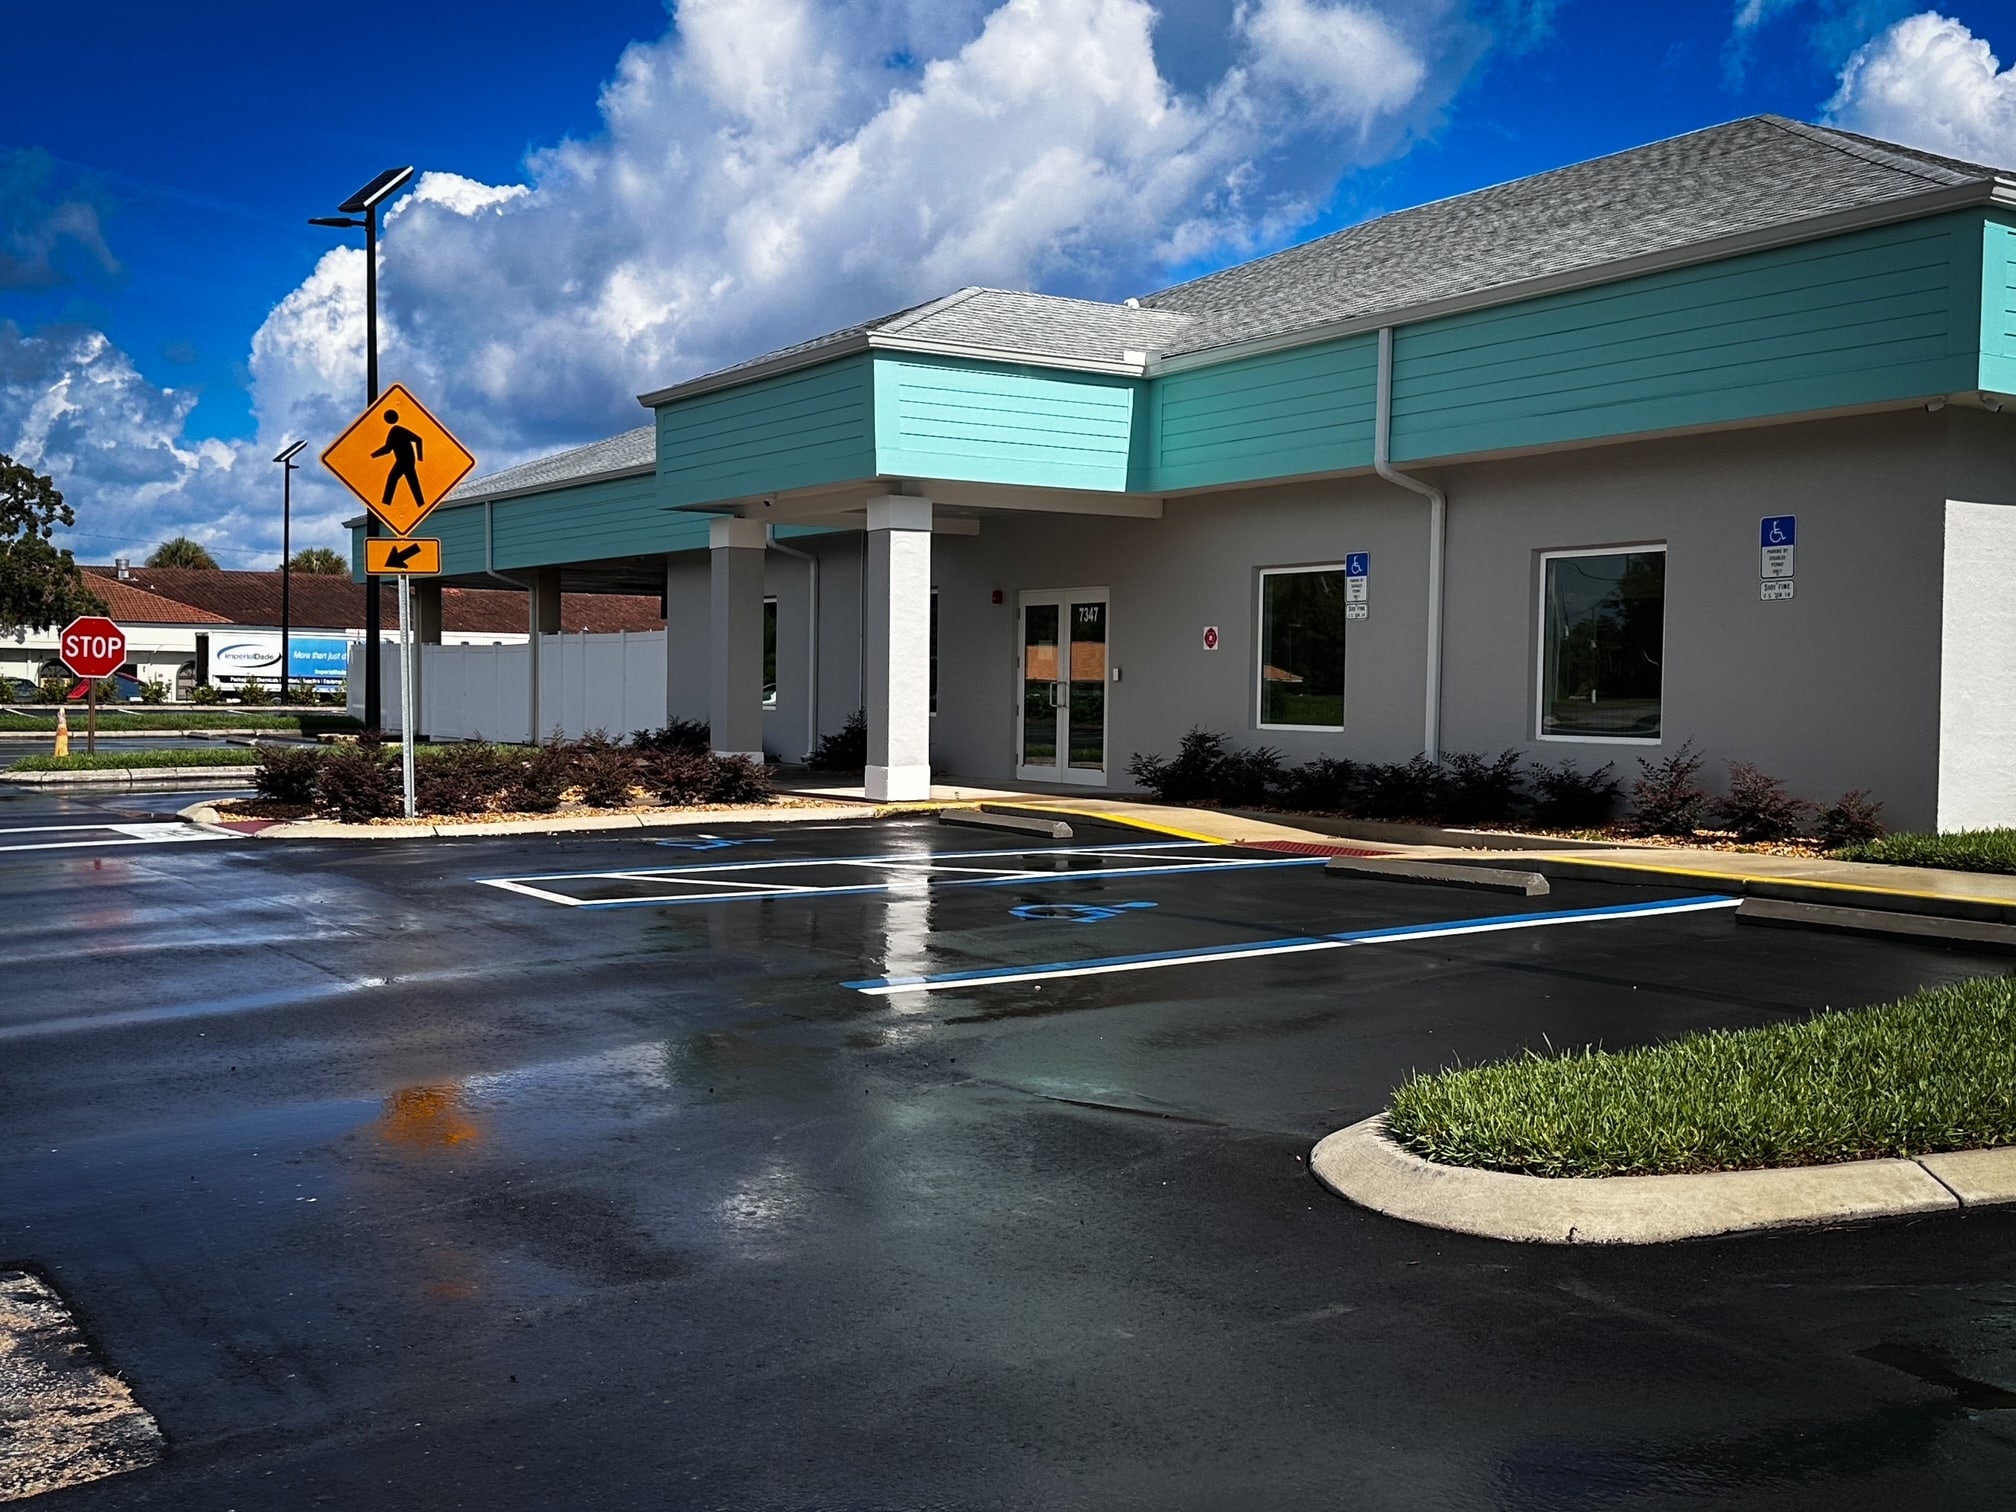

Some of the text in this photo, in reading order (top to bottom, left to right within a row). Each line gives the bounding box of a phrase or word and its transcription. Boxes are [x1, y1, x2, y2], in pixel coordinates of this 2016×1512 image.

[1079, 607, 1099, 622] 7347
[65, 635, 122, 659] STOP
[293, 651, 311, 659] More
[312, 651, 327, 660] than
[327, 652, 341, 661] just
